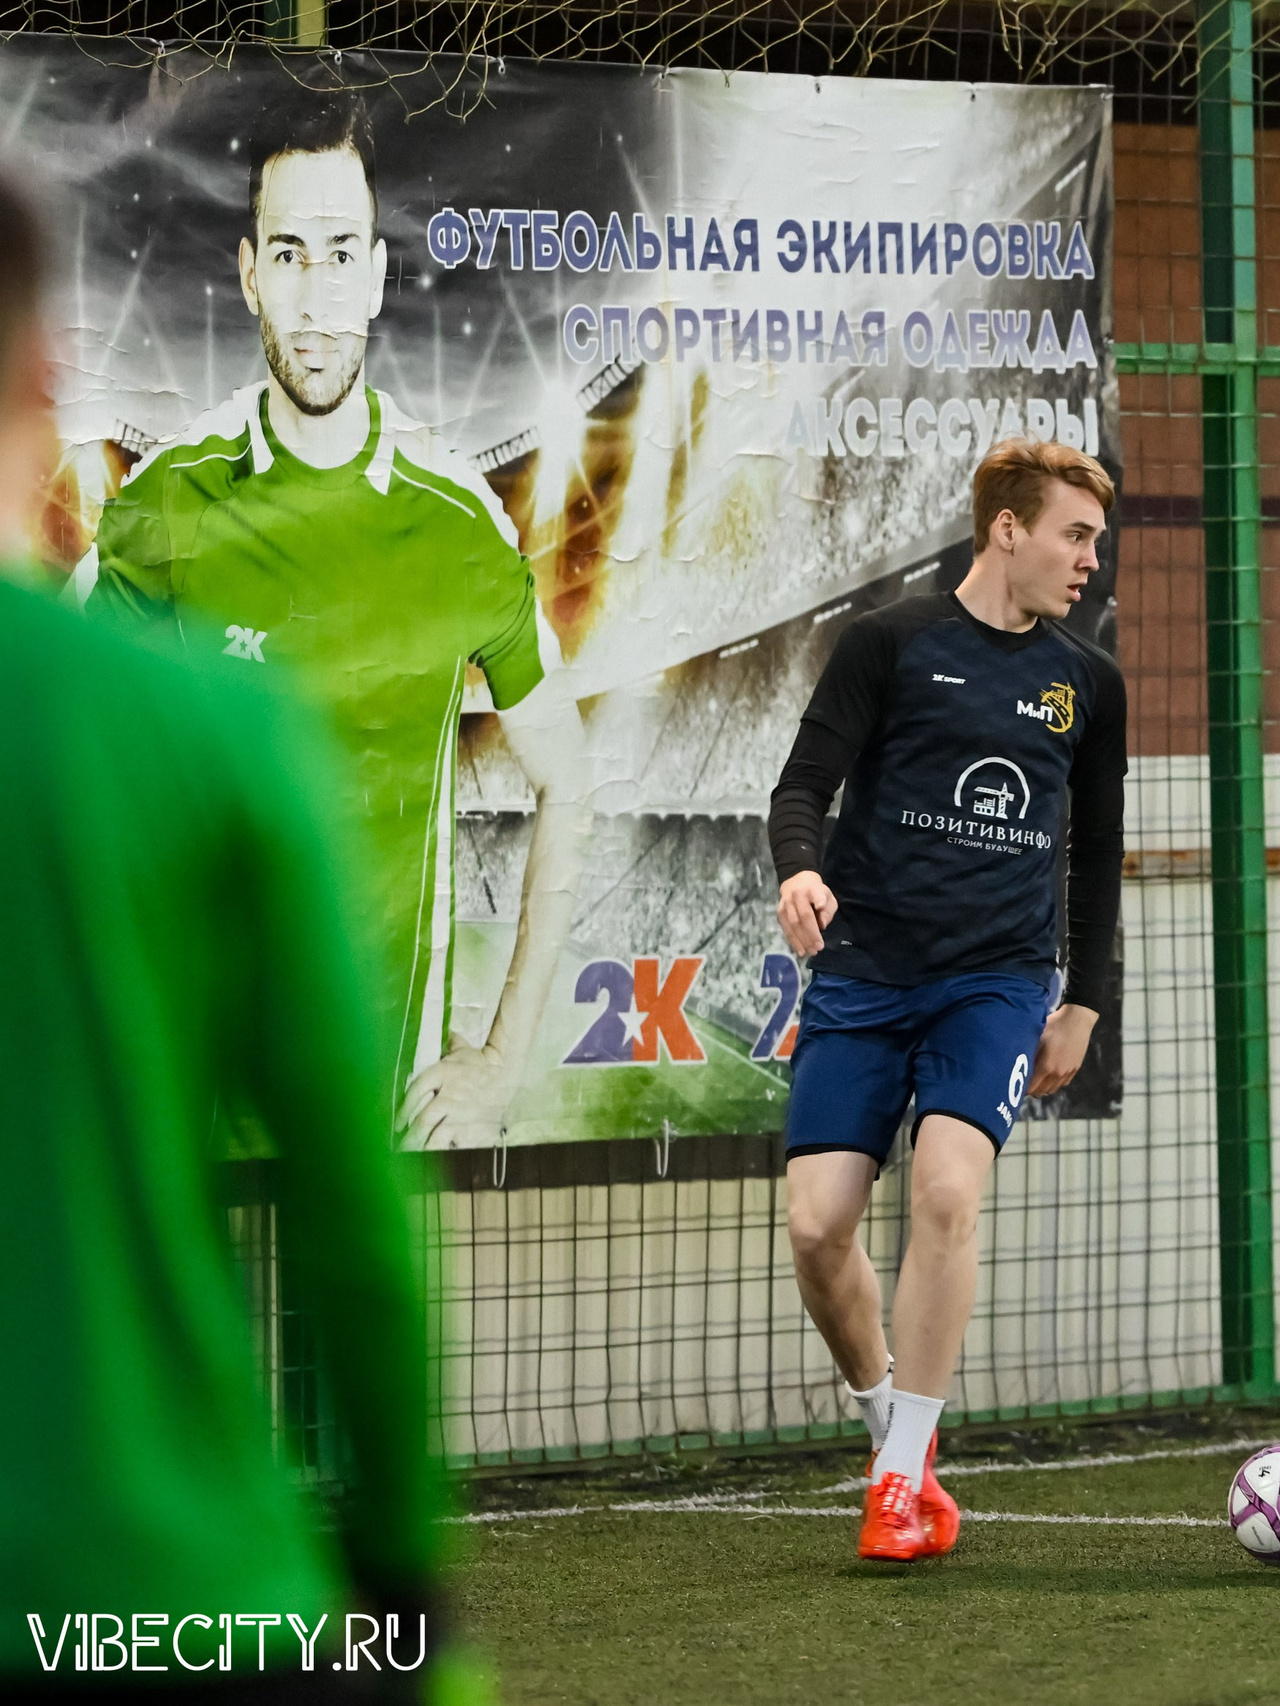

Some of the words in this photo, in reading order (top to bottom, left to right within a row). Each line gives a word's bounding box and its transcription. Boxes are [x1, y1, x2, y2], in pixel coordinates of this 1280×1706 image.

[427, 207, 760, 273] ФУТБОЛЬНАЯ
[776, 219, 1095, 280] ЭКИПИРОВКА
[563, 303, 886, 367] СПОРТИВНАЯ
[902, 309, 1098, 374] ОДЕЖДА
[222, 624, 268, 663] 2K
[901, 810, 1051, 849] ПОЗИТИВИНФО
[947, 836, 983, 849] СТРОИМ
[562, 955, 707, 1066] 2K
[1008, 1053, 1028, 1108] 6
